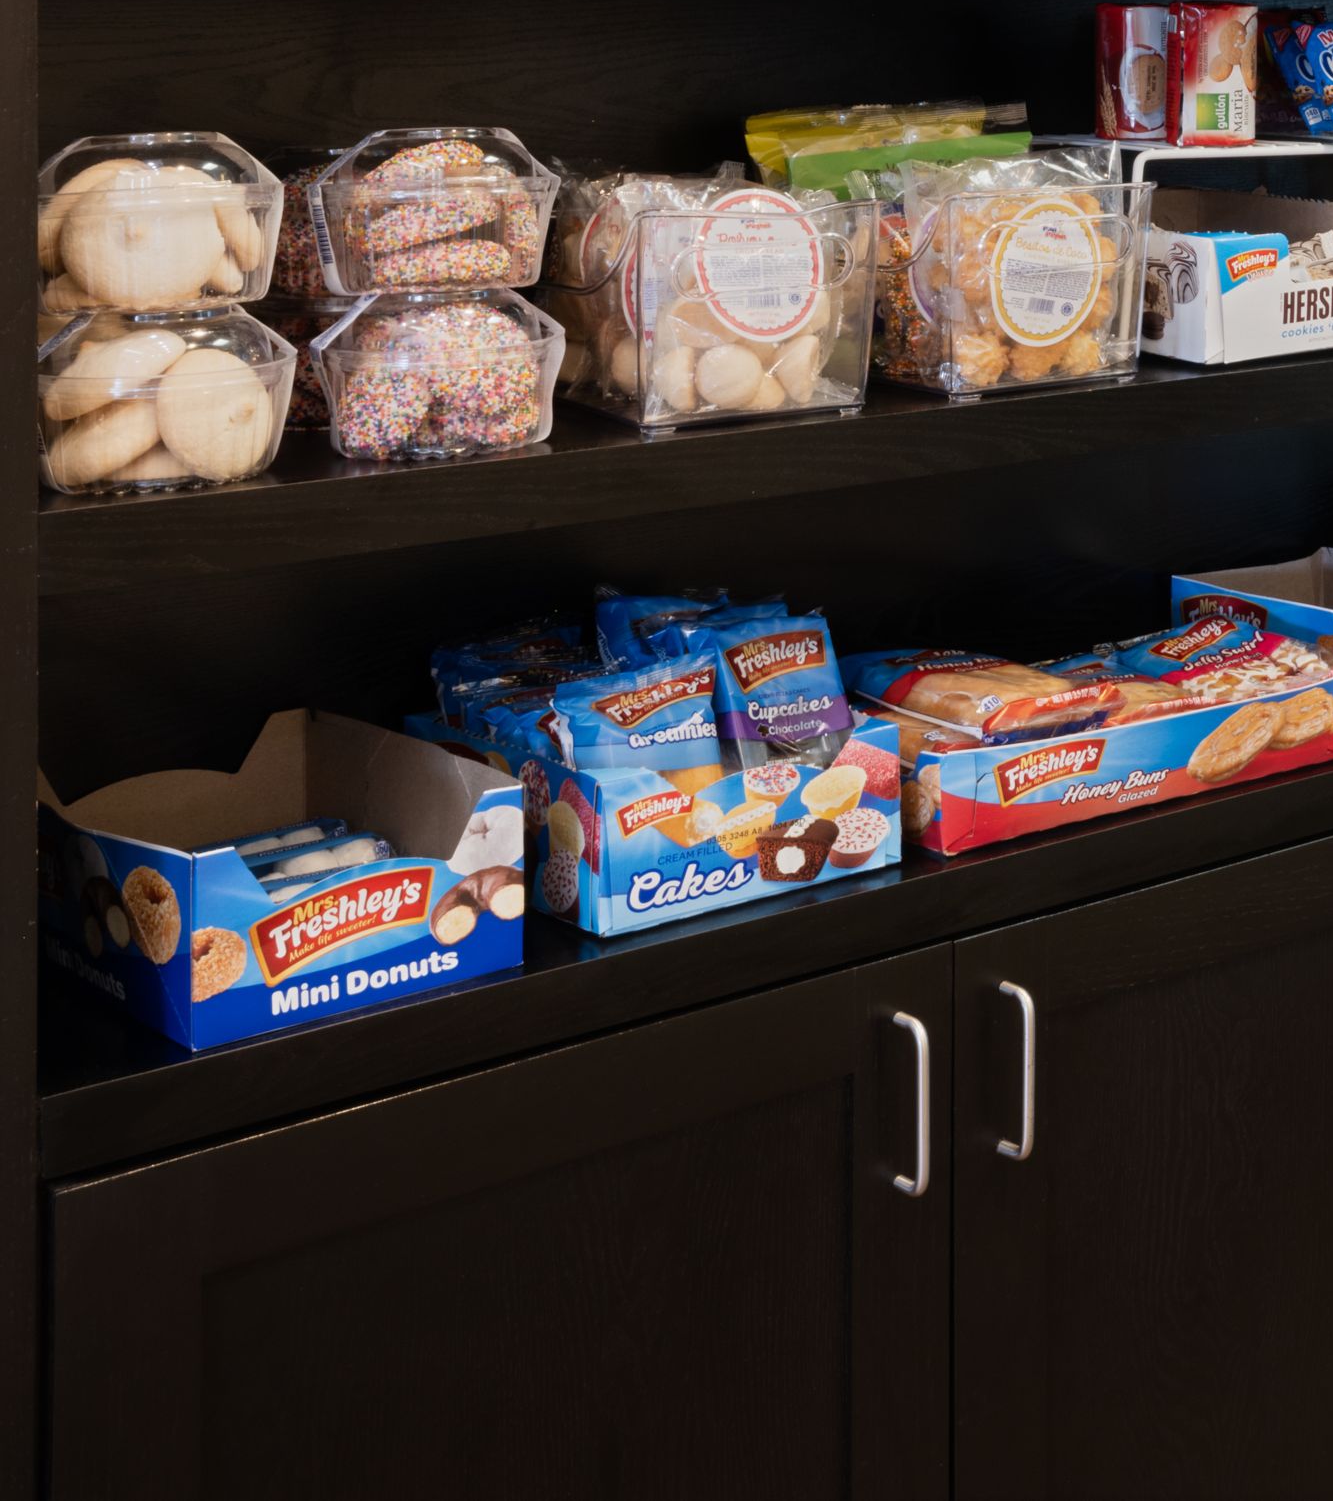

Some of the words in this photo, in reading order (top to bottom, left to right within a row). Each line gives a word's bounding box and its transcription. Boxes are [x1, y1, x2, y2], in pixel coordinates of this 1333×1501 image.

[1231, 252, 1277, 276] Freshley's
[734, 637, 818, 678] Freshley's
[1184, 654, 1223, 672] Jelly
[1224, 631, 1264, 658] Swirl
[748, 695, 833, 722] Cupcakes
[983, 695, 1001, 711] 410
[769, 719, 822, 735] Chocolate
[1005, 739, 1099, 792] Freshley's
[1061, 776, 1124, 806] Honey
[1125, 767, 1168, 792] Buns
[1118, 785, 1158, 804] Glazed
[624, 795, 691, 828] Freshley's
[657, 850, 695, 866] CREAM
[697, 842, 733, 856] FILLED
[628, 860, 752, 911] Cakes
[269, 879, 421, 958] Freshley's
[293, 894, 338, 925] Mrs.
[289, 942, 316, 963] Make
[317, 932, 334, 951] life
[335, 914, 377, 942] sweeter!
[271, 977, 340, 1016] Mini
[347, 949, 459, 996] Donuts
